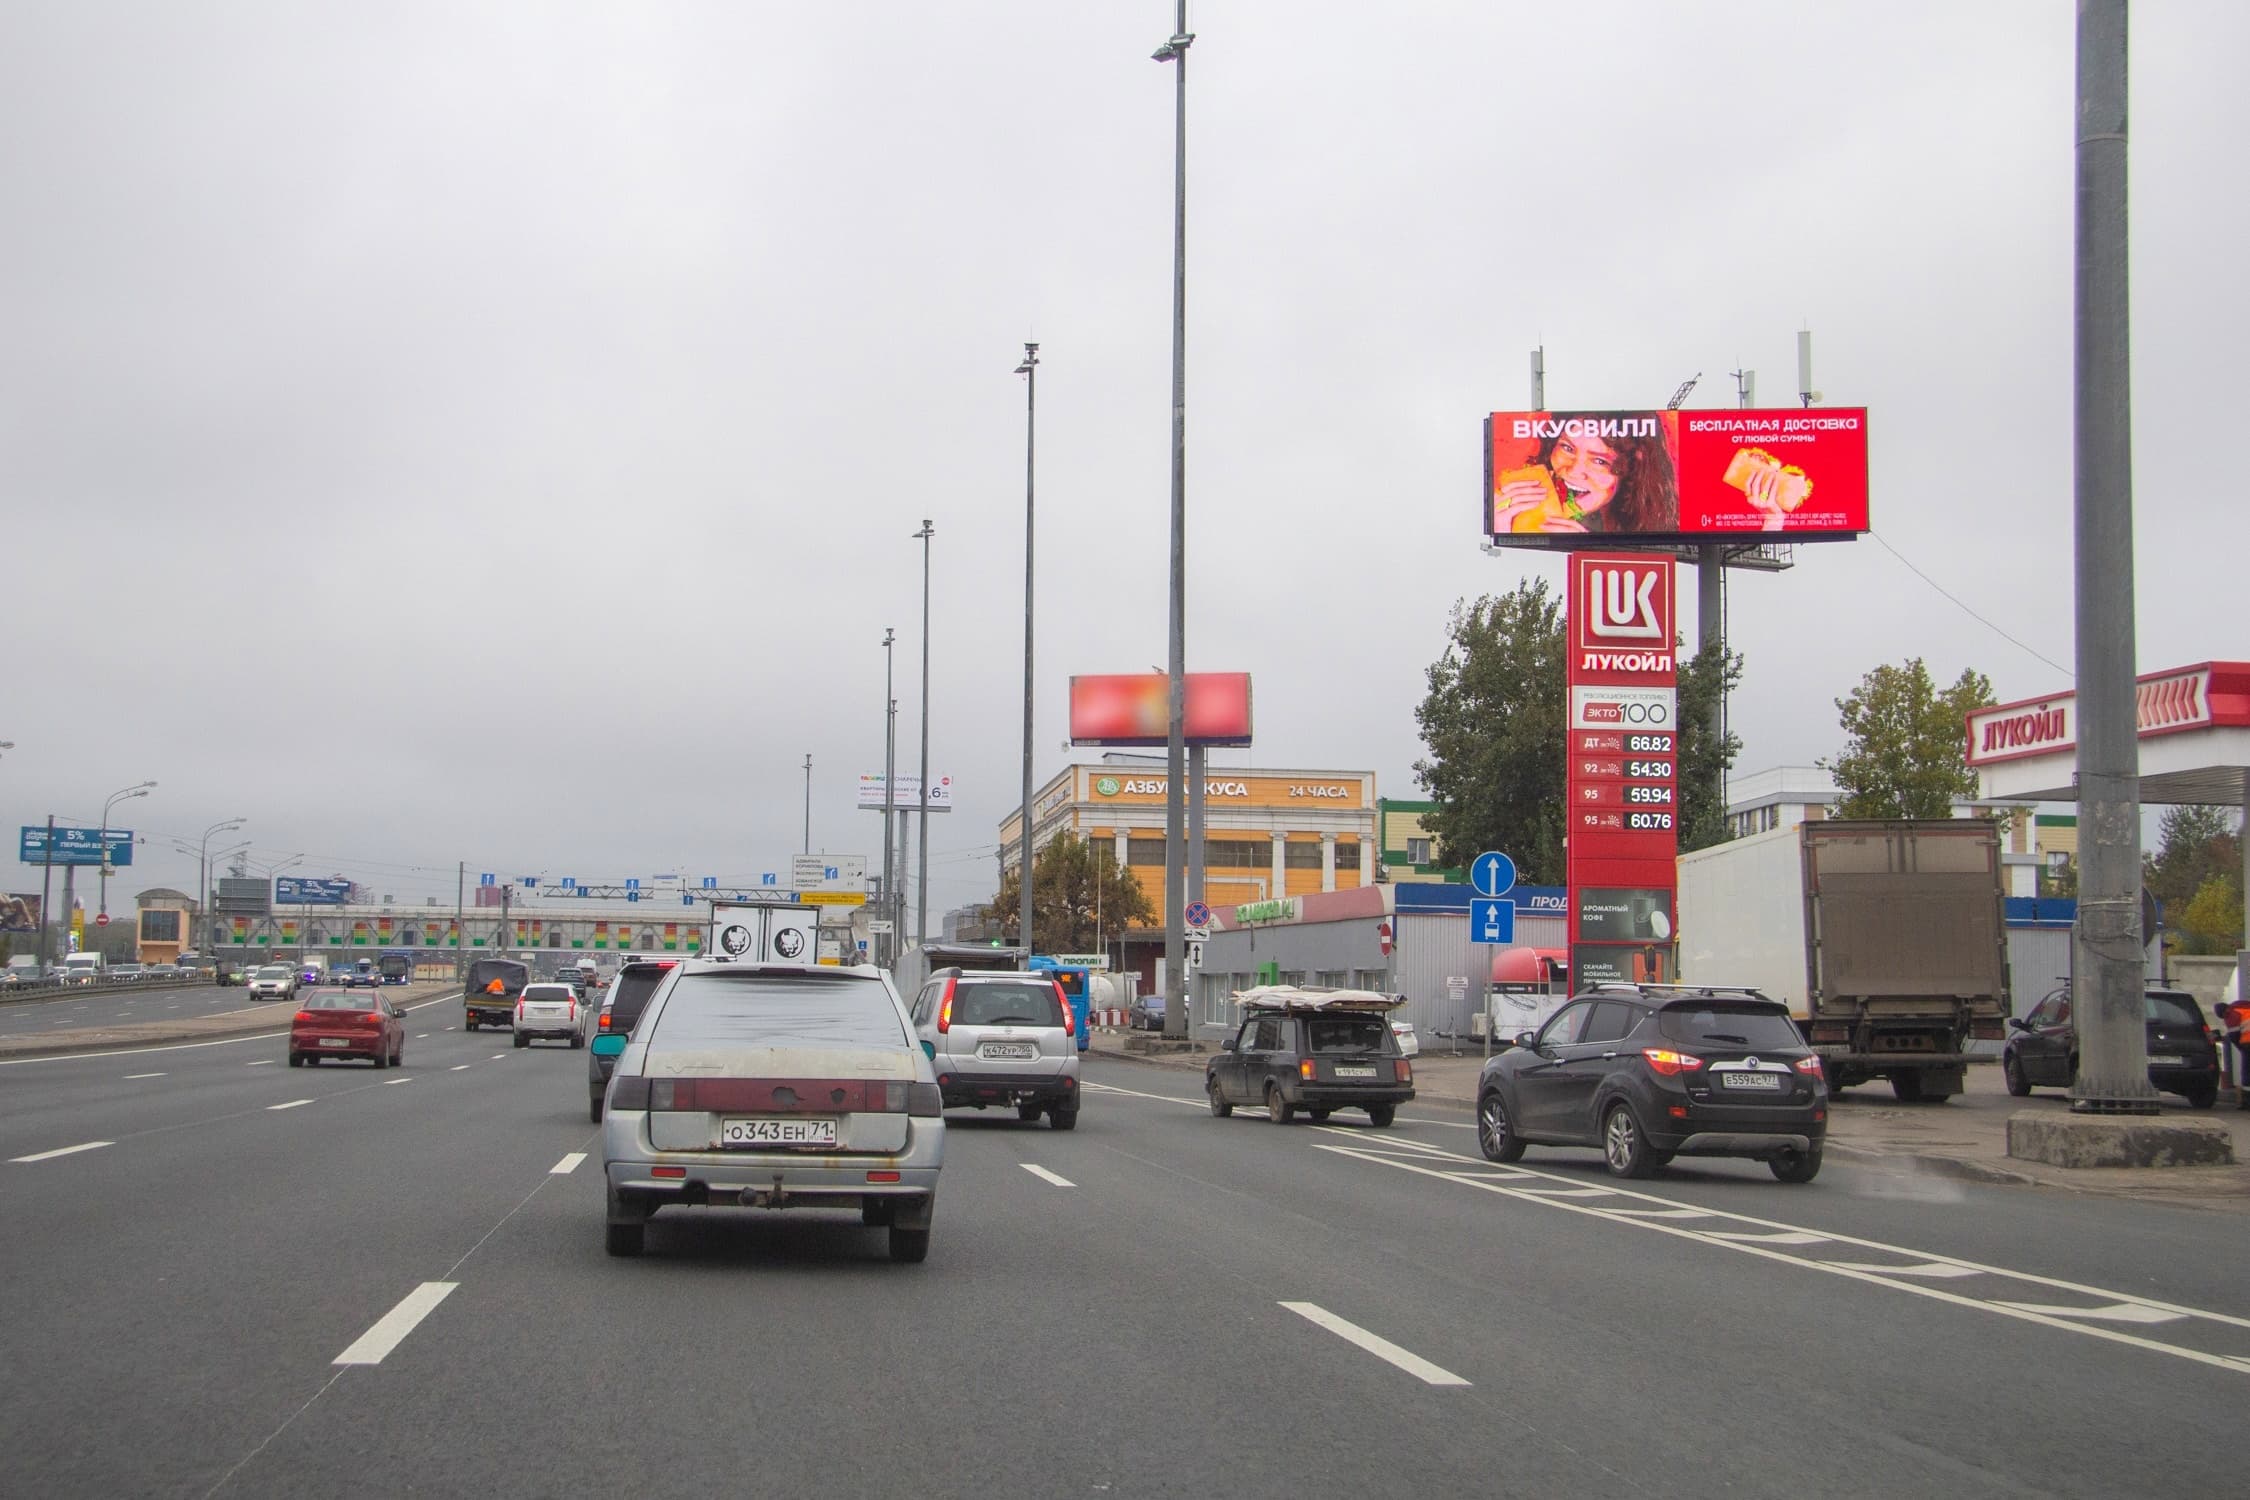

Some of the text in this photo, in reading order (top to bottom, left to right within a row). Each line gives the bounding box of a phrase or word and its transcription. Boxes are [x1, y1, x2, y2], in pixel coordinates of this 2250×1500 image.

[1512, 419, 1656, 438] ВКУСВИЛЛ
[1732, 434, 1815, 443] ОТ ЛЮБОЙ СУММЫ
[1701, 514, 1712, 527] 0+
[1582, 651, 1671, 672] ЛУКОЙЛ
[1587, 703, 1667, 723] ЭКТО 100
[1982, 703, 2065, 752] ЛУКОЙЛ
[1584, 736, 1672, 751] ДТ 66.82
[1584, 762, 1672, 777] 92 54.30
[1124, 780, 1349, 798] АЗБУ КУСА 24 ЧАСА
[1584, 788, 1672, 803] 95 59.94
[1584, 813, 1672, 829] 95 60.76
[67, 830, 85, 840] 5%
[1582, 904, 1629, 912] АРОМАТНЫЙ
